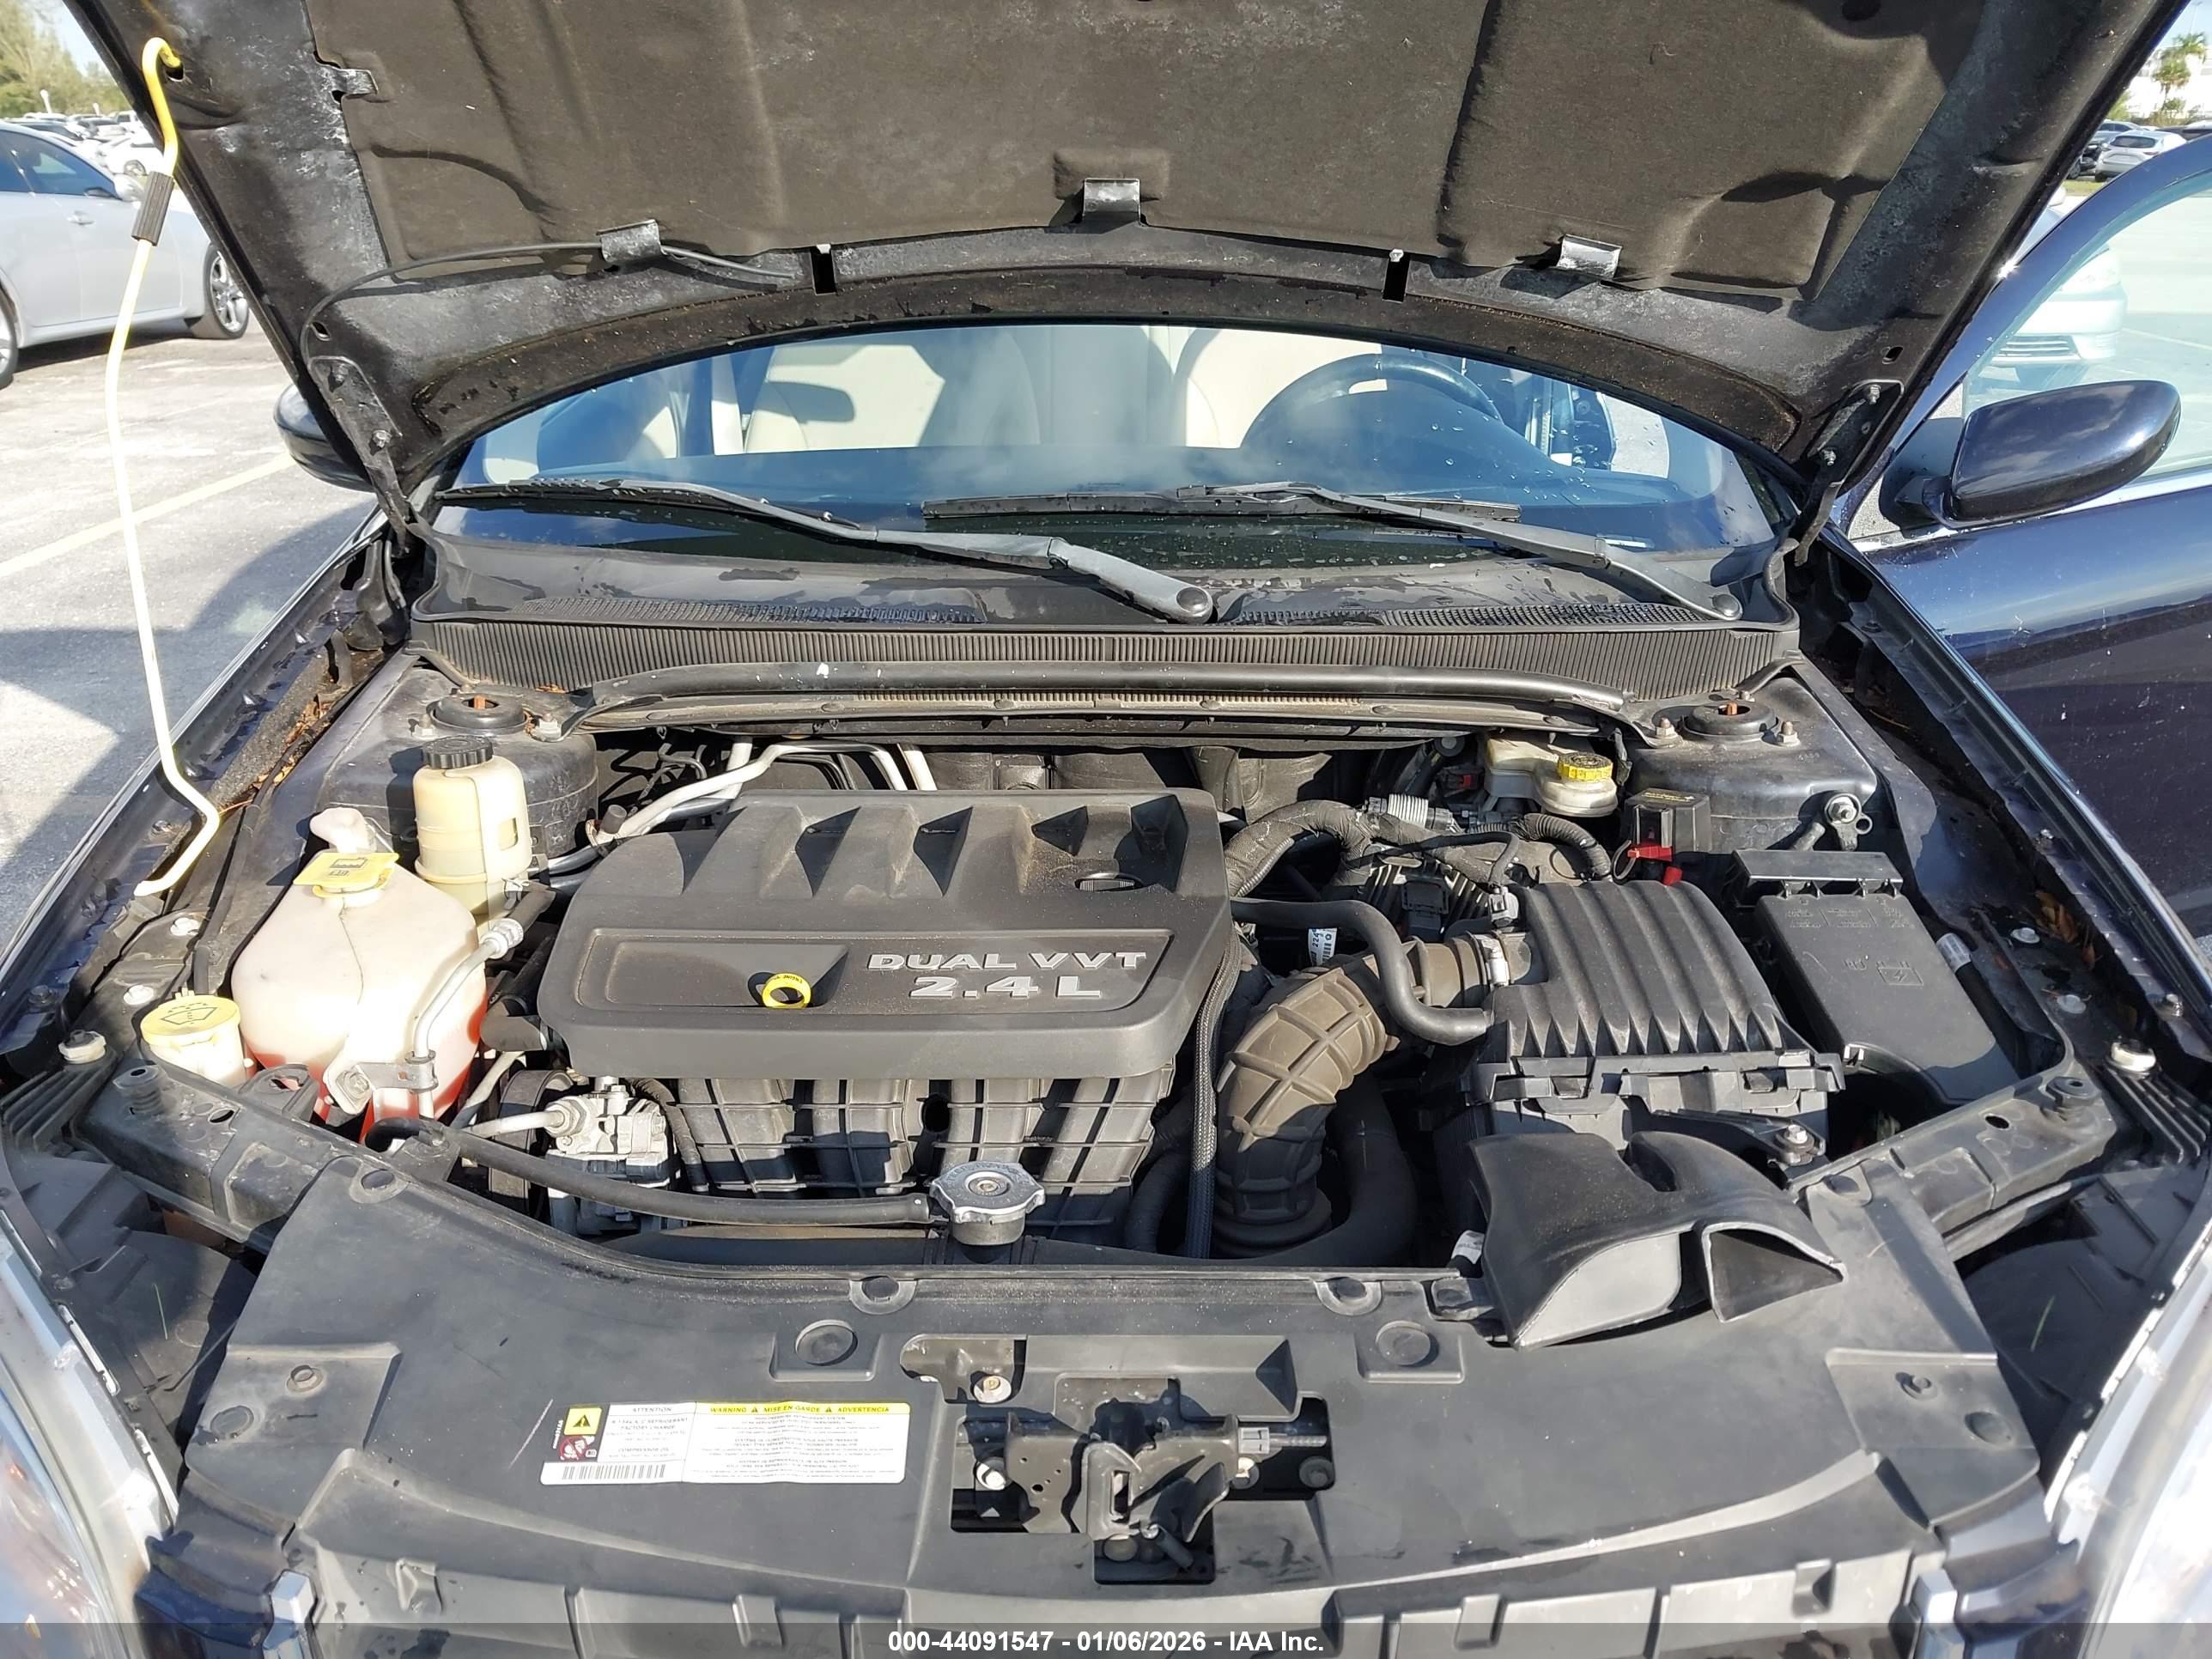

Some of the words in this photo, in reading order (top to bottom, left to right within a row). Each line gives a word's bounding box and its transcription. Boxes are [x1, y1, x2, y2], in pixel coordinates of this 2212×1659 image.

[867, 952, 1018, 970] DUAL
[1029, 951, 1147, 969] VVT
[909, 975, 1040, 999] 2.4
[794, 1405, 820, 1413] GARDE
